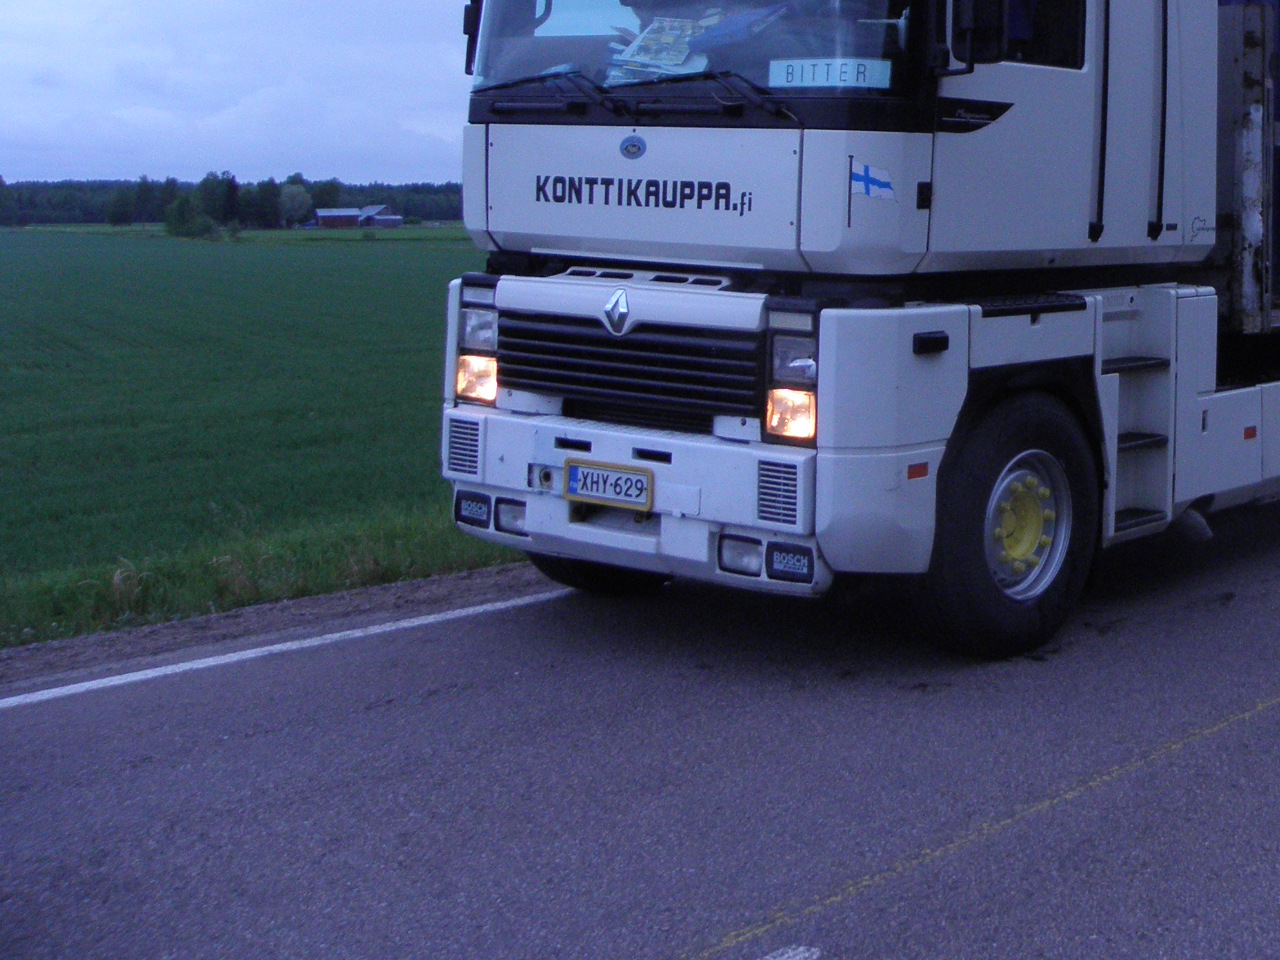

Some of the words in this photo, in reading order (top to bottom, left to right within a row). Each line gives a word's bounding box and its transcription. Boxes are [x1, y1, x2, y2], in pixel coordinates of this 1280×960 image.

[786, 63, 867, 83] BITTER
[535, 175, 753, 217] KONTTIKAUPPA.fi
[580, 470, 644, 498] XHY-629
[773, 551, 808, 567] BOSCH
